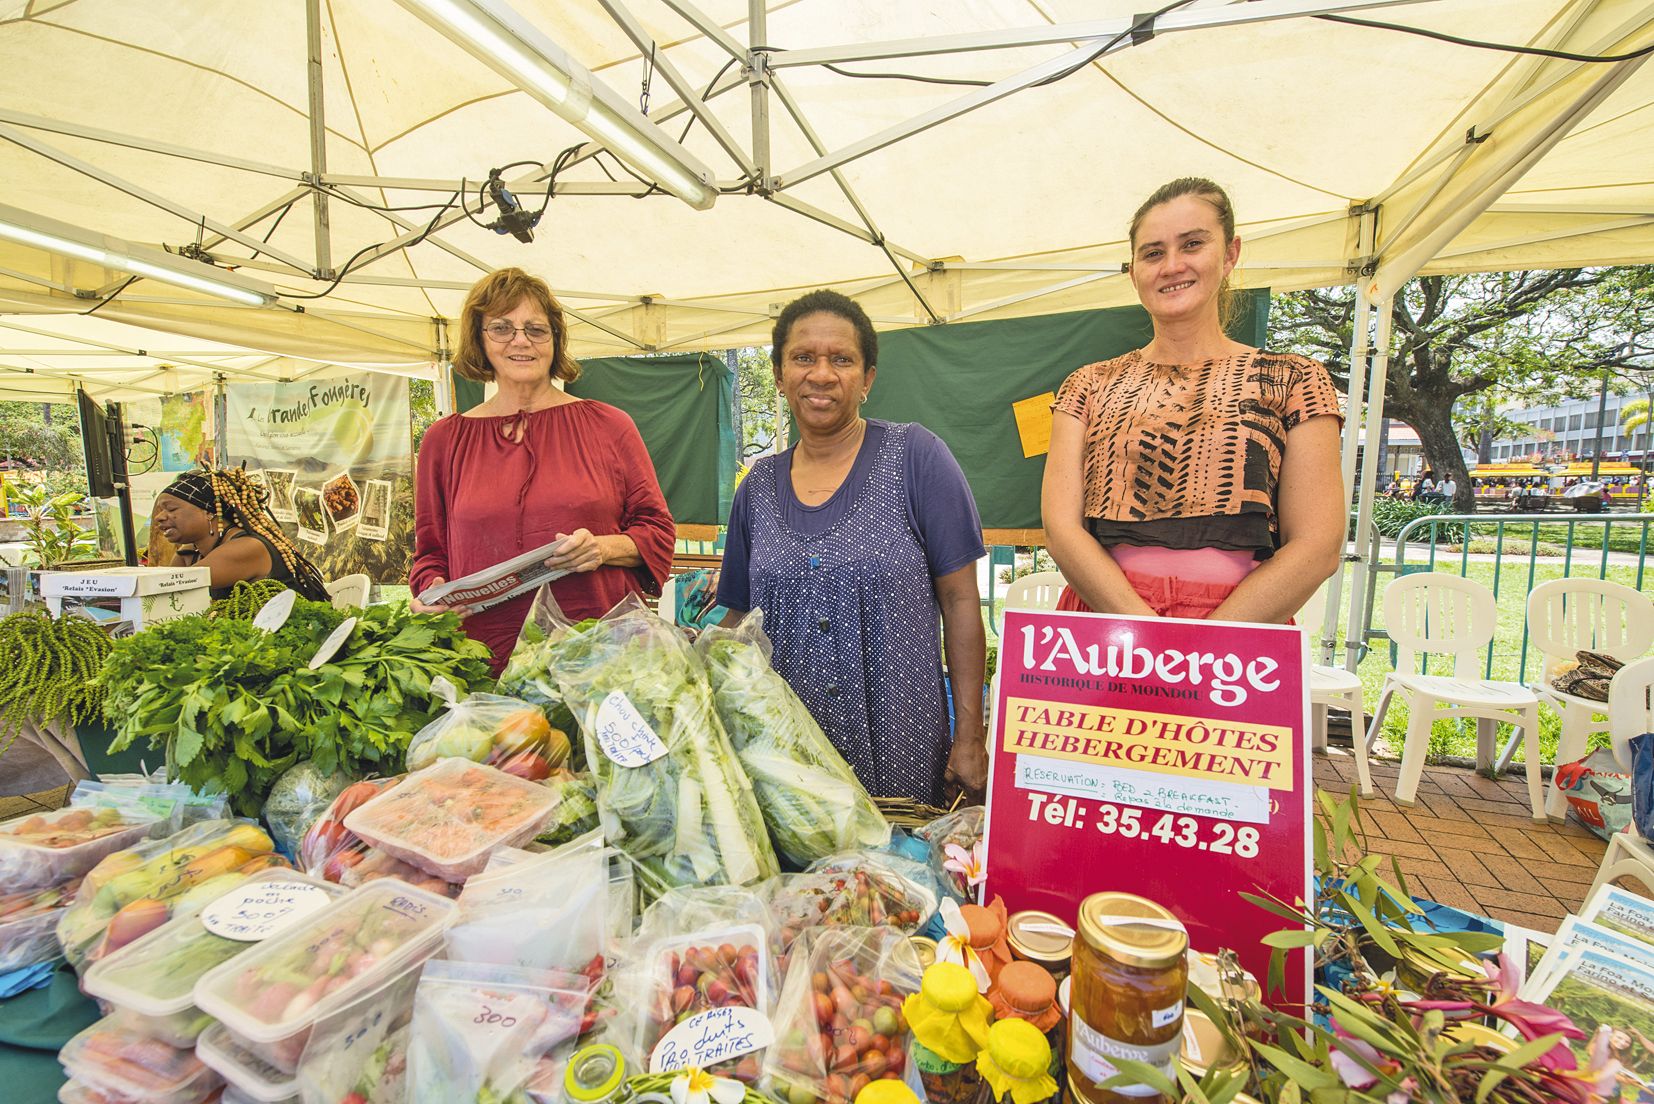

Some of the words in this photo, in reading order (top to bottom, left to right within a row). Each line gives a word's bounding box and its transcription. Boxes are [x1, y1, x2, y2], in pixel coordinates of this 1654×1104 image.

[445, 575, 518, 606] Nouvelles
[1020, 624, 1281, 708] l'Auberge
[1019, 673, 1105, 693] HISTORIQUE
[1107, 681, 1128, 695] DE
[1129, 684, 1204, 702] MOINDOU
[1016, 704, 1116, 735] TABLE
[1122, 718, 1281, 754] D'HÔTES
[1013, 729, 1282, 780] HEBERGEMENT
[1113, 779, 1136, 794] BED
[1027, 792, 1087, 829] Tél:
[1096, 804, 1261, 859] 35.43.28
[1609, 902, 1624, 911] La
[1574, 933, 1589, 943] La
[1577, 966, 1617, 985] Farino
[1581, 960, 1596, 969] La
[473, 1005, 517, 1028] 300
